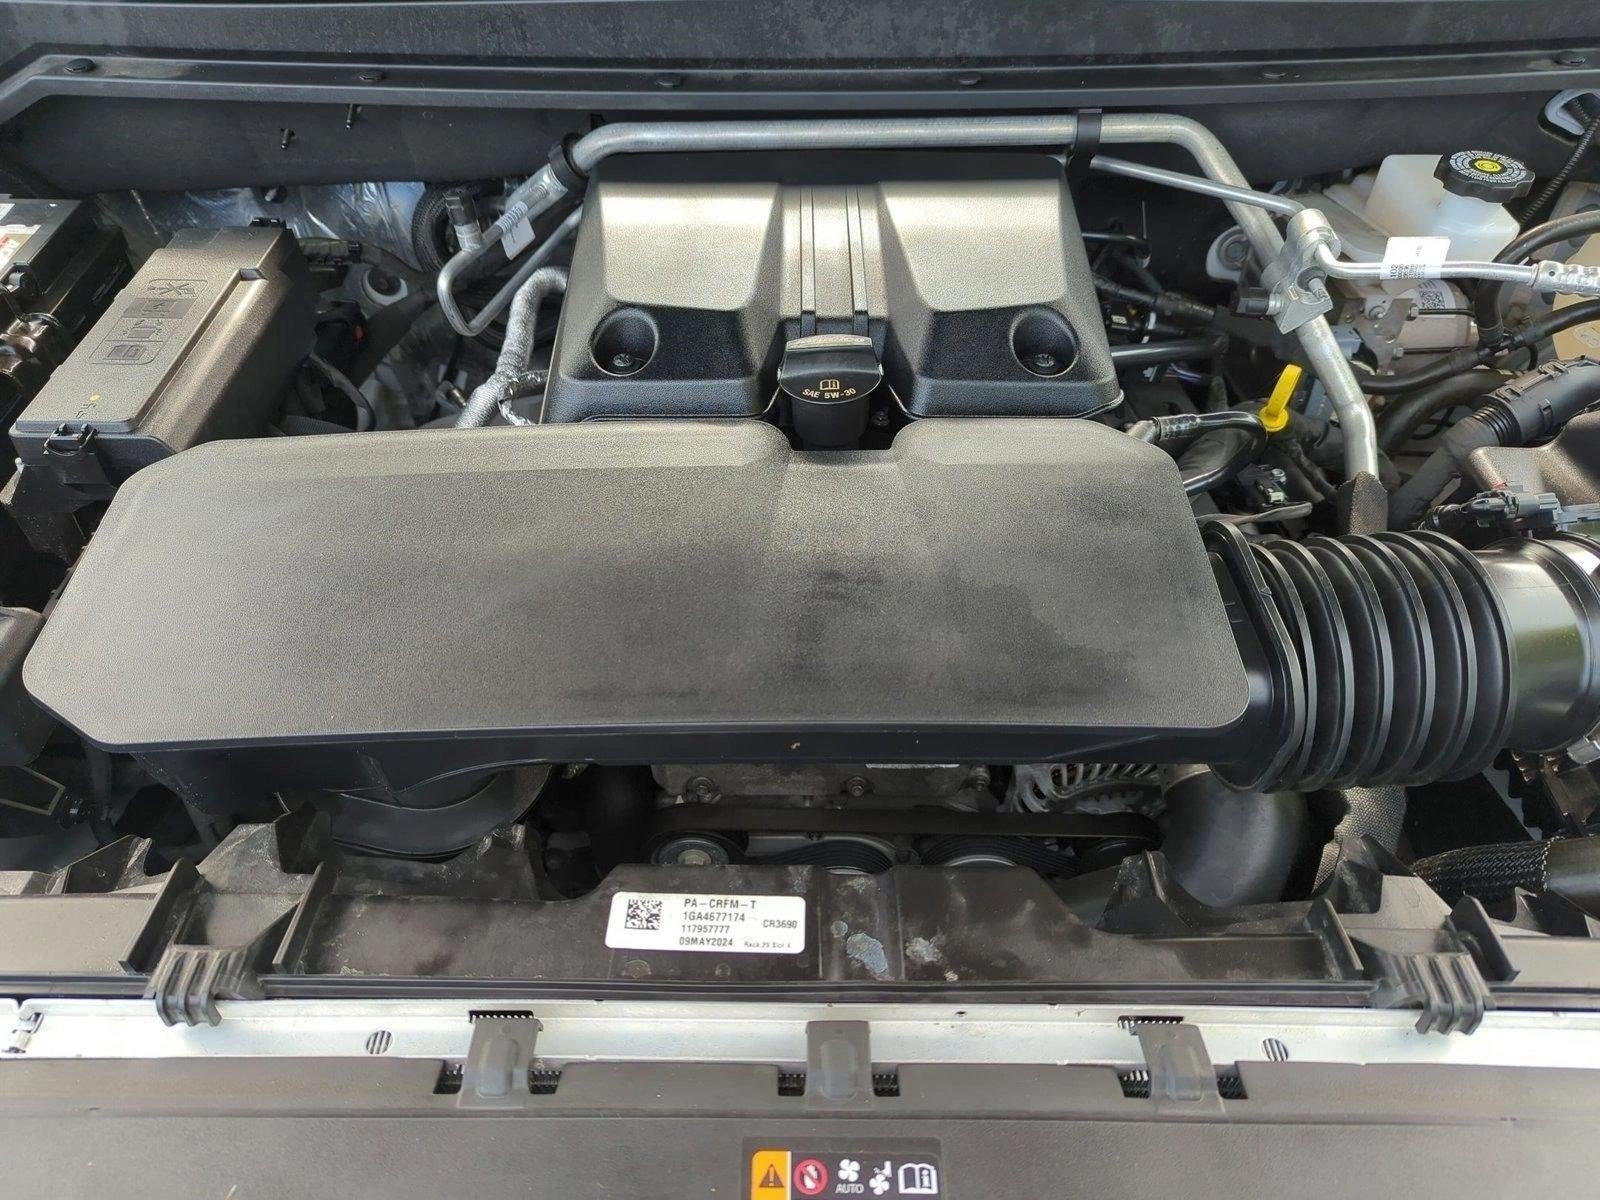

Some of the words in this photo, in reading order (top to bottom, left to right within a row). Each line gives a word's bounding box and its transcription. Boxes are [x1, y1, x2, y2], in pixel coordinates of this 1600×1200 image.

[802, 388, 821, 399] SAE
[824, 387, 857, 399] 5W-30
[682, 911, 746, 922] 1GA4677174
[681, 924, 731, 934] 117957777
[762, 919, 798, 929] CR3690
[679, 936, 734, 947] 09MAY2024
[835, 1183, 865, 1194] AUTO
